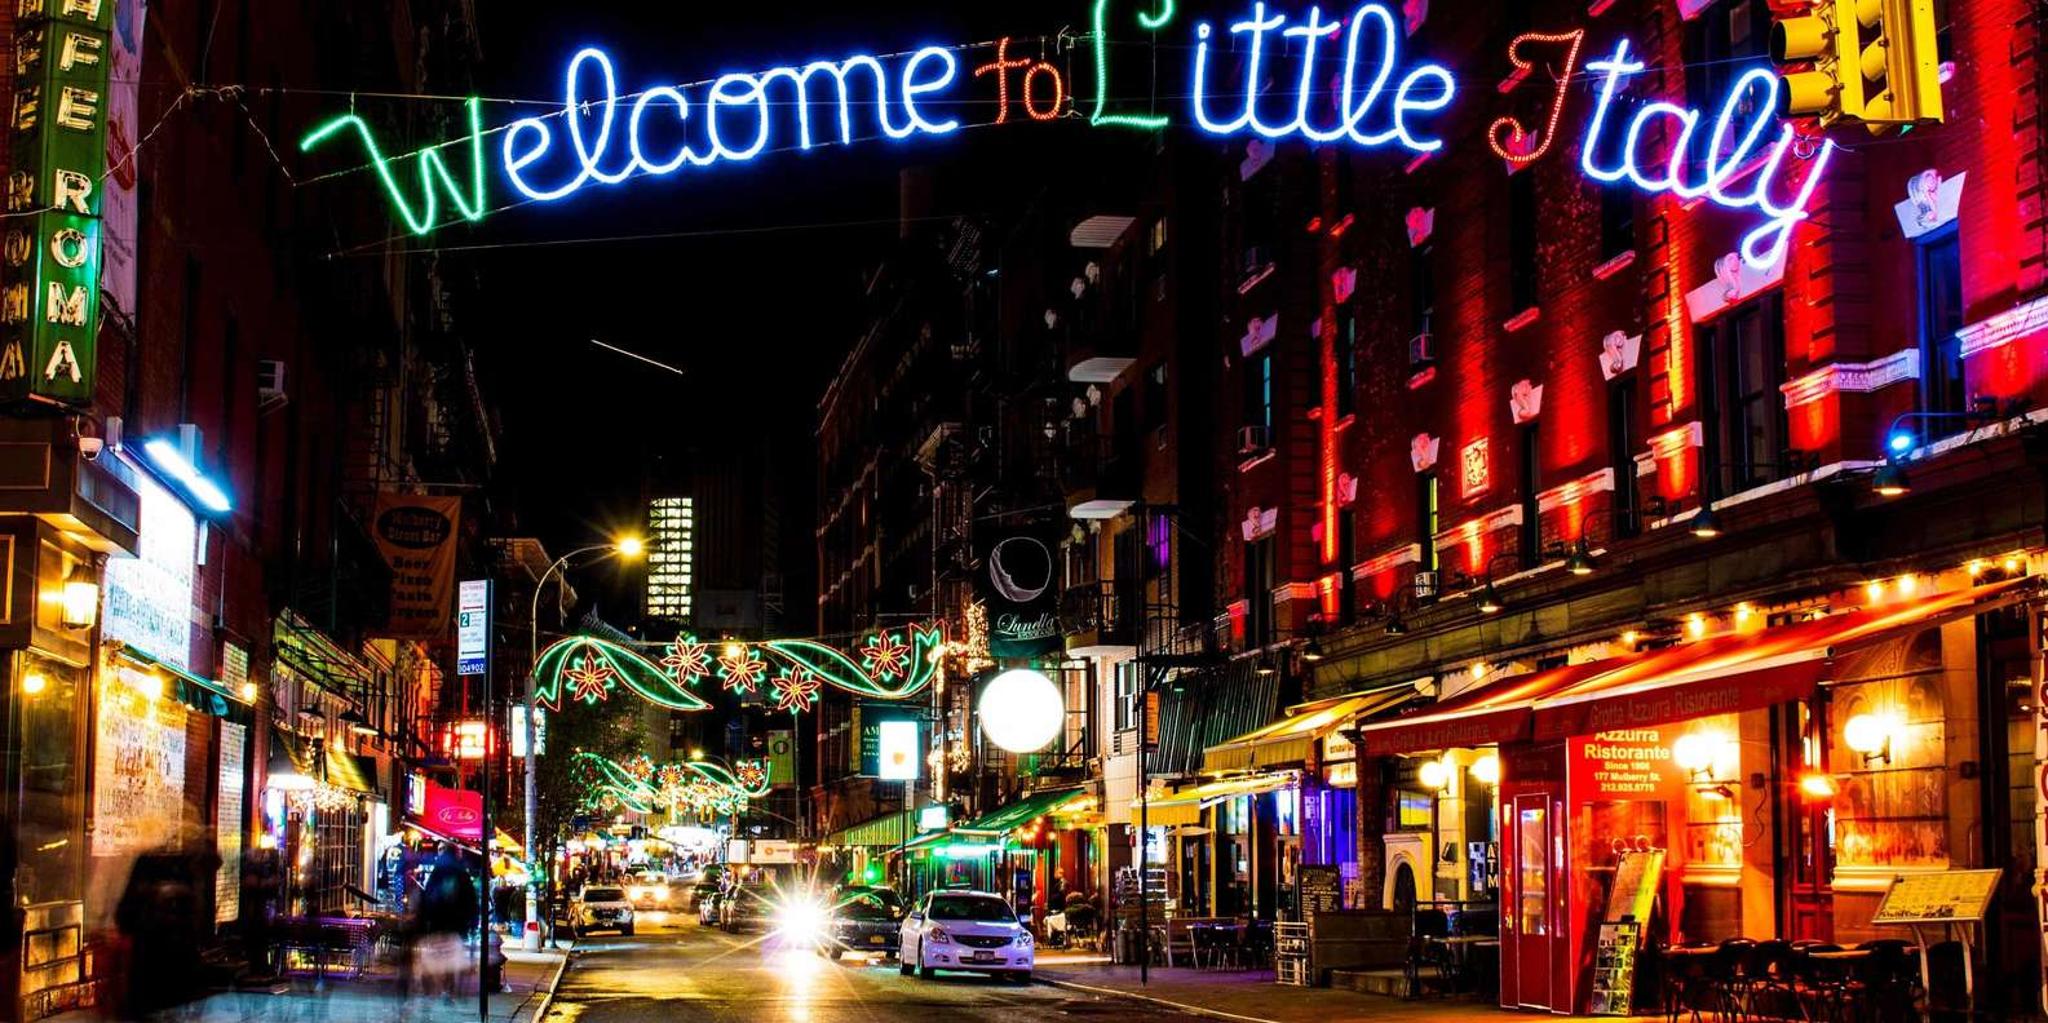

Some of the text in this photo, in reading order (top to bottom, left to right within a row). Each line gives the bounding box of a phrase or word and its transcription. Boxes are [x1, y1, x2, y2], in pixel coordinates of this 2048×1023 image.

[300, 46, 960, 235] Welcome
[973, 36, 1063, 125] to
[1089, 0, 1456, 152] Little
[1486, 28, 1836, 271] Italy
[45, 167, 93, 384] ROMA
[461, 611, 469, 628] 2
[1674, 686, 1740, 715] Ristorante
[1594, 729, 1660, 742] Azzurra
[1584, 743, 1670, 760] Ristorante
[1604, 761, 1629, 771] Since
[1610, 771, 1648, 783] Mulberry
[1487, 843, 1499, 889] ATM
